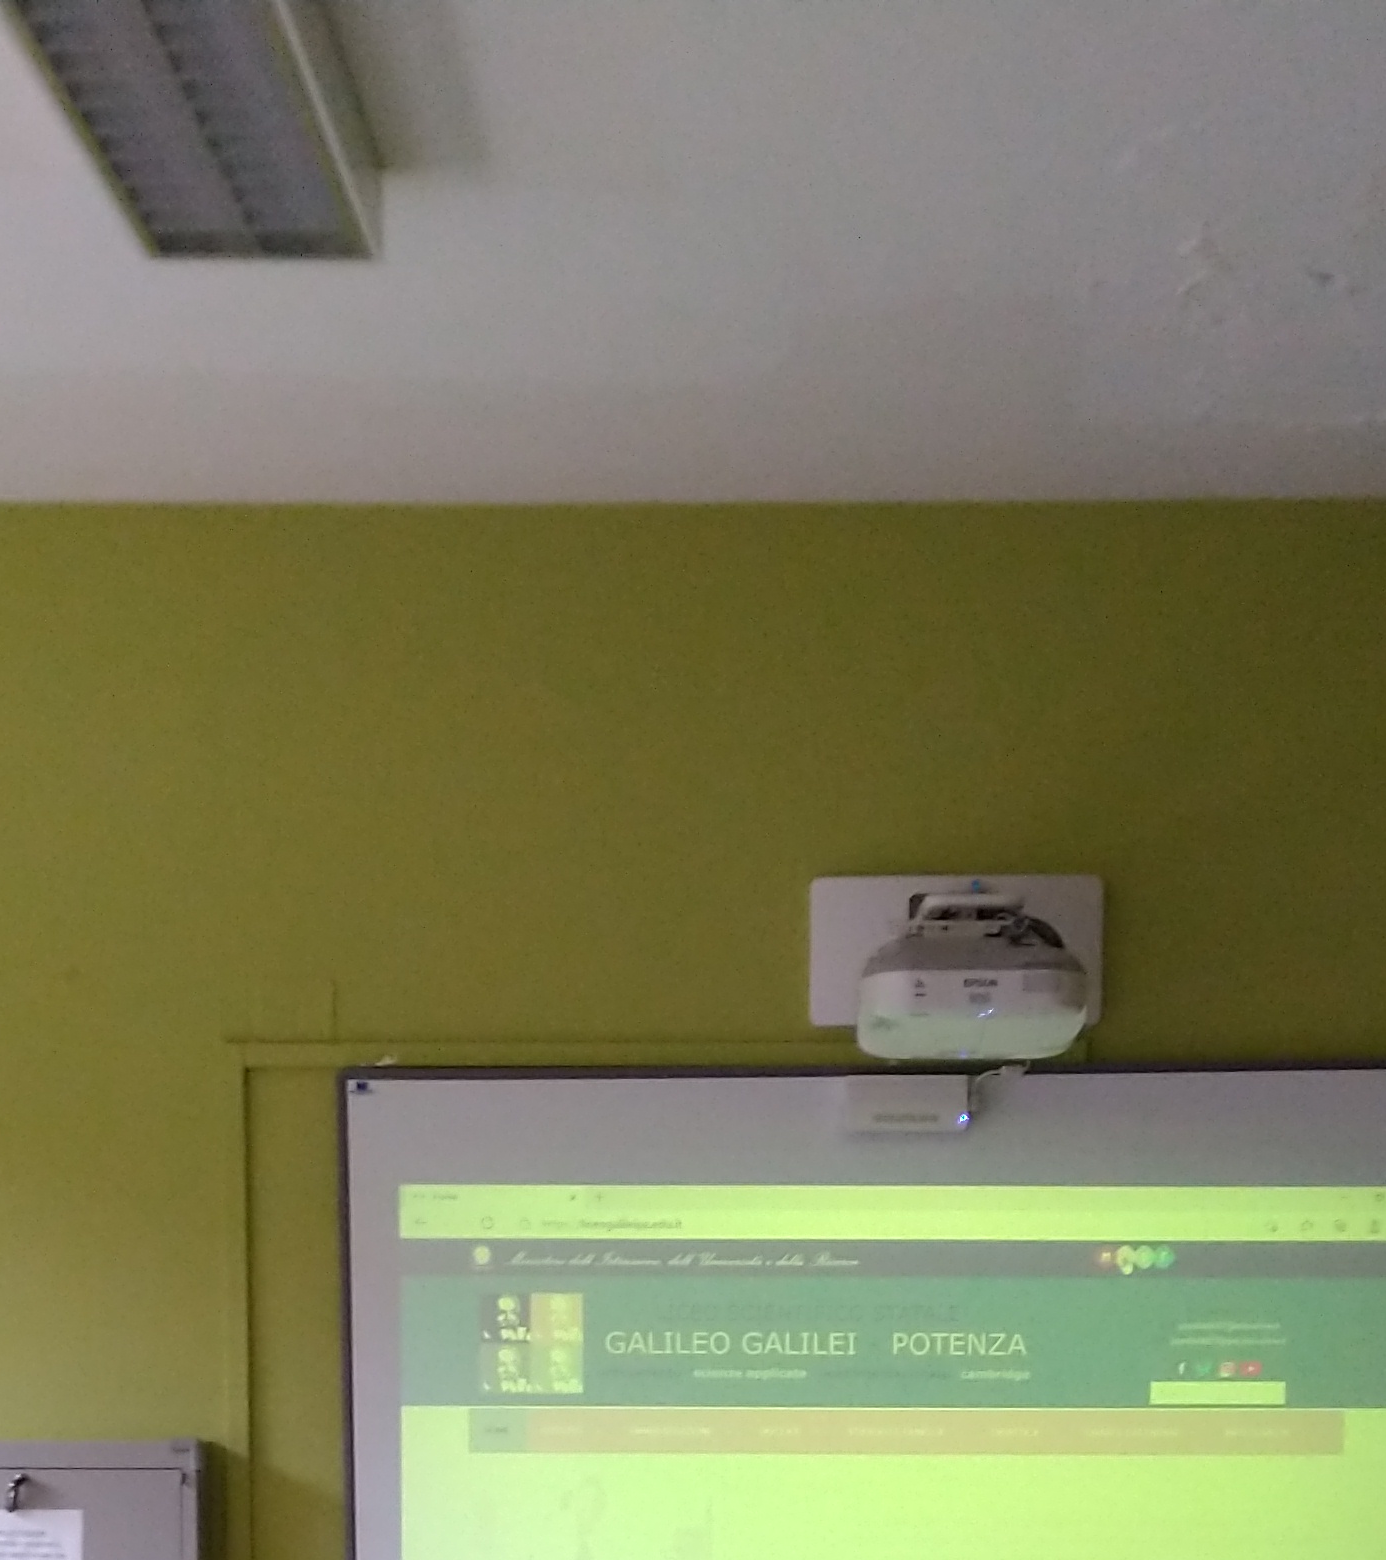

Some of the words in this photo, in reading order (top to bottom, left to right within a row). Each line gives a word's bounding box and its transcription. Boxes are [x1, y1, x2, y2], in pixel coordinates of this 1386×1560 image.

[604, 1331, 731, 1355] GALILEO
[741, 1331, 857, 1356] GALILEI
[891, 1332, 1028, 1356] POTENZA
